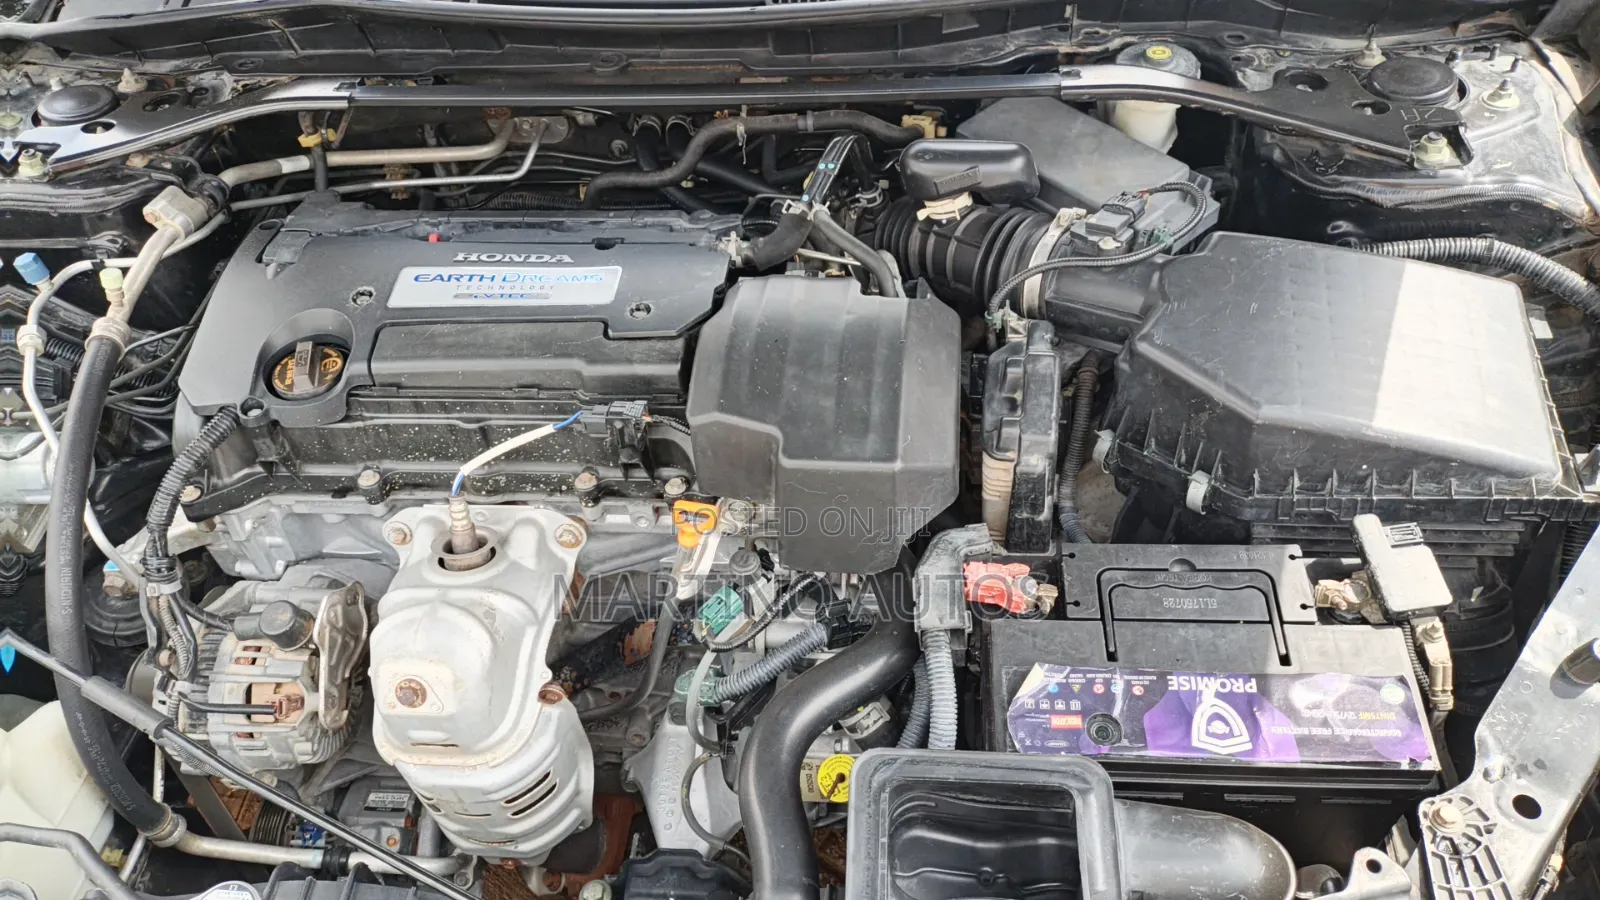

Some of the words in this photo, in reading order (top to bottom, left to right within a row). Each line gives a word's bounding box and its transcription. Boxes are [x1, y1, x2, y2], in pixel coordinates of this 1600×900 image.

[452, 252, 575, 263] HONDA
[413, 273, 495, 283] EARTH
[501, 272, 604, 283] DREAMS
[1167, 675, 1257, 694] PROMISE
[1309, 726, 1333, 735] FREE
